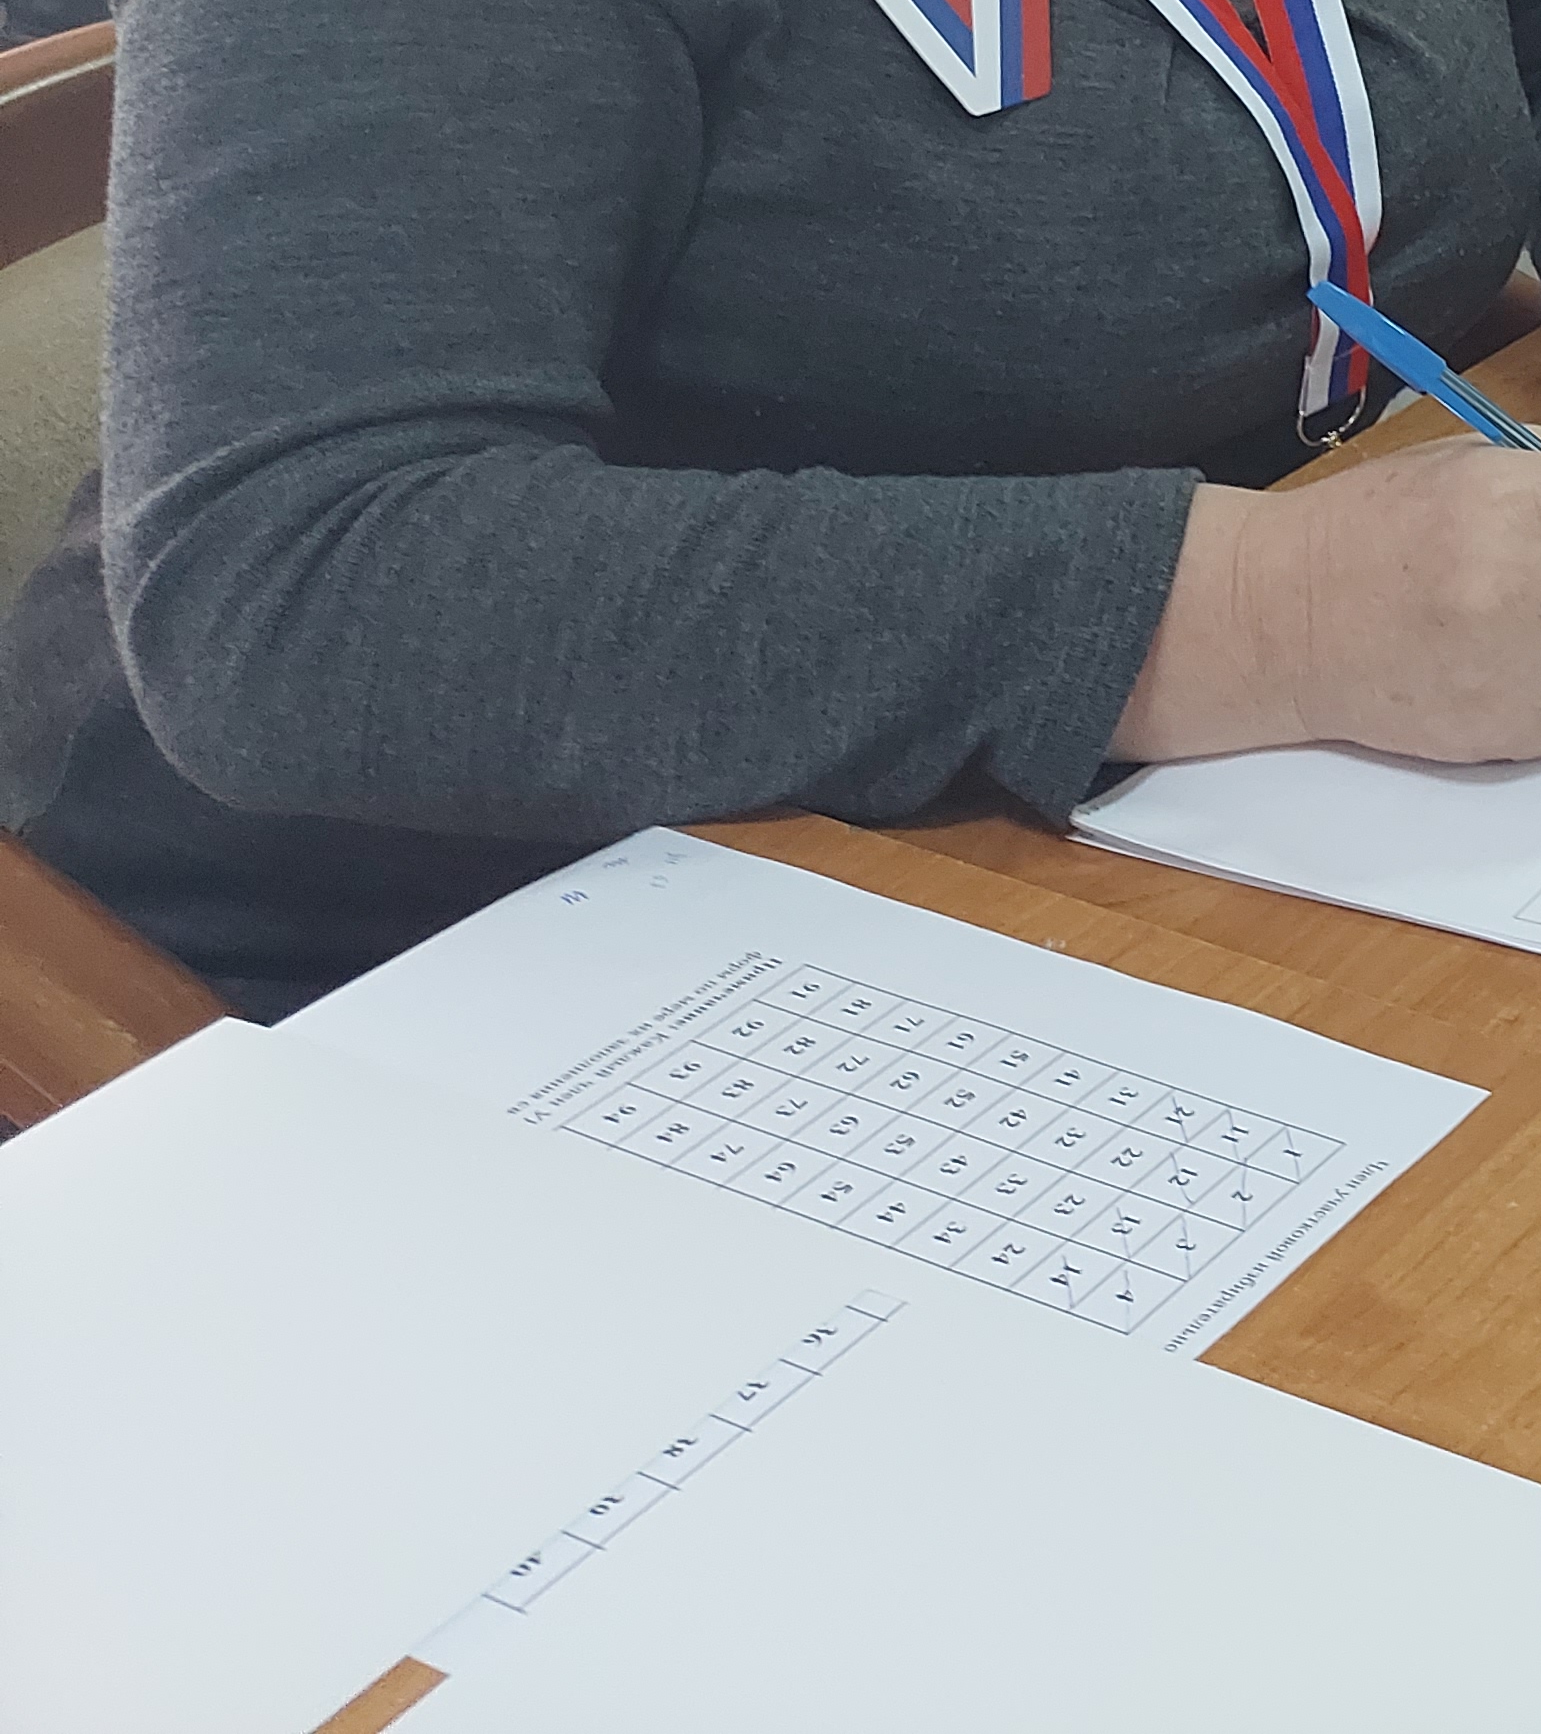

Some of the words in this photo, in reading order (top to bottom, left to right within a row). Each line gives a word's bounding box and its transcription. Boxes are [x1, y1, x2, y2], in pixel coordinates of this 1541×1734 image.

[785, 980, 825, 1001] 91
[836, 997, 875, 1017] 81
[727, 1017, 769, 1039] 92
[888, 1014, 927, 1035] 71
[778, 1034, 820, 1057] 82
[940, 1031, 980, 1052] 61
[663, 1059, 706, 1082] 93
[831, 1052, 873, 1075] 72
[994, 1049, 1034, 1071] 51
[714, 1077, 758, 1100] 83
[884, 1070, 926, 1093] 62
[1049, 1067, 1088, 1089] 41
[768, 1095, 811, 1119] 73
[939, 1088, 981, 1112] 52
[1104, 1085, 1144, 1107] 31
[596, 1102, 641, 1126] 94
[821, 1114, 865, 1138] 63
[994, 1107, 1036, 1130] 42
[1159, 1103, 1199, 1126] 21
[649, 1121, 693, 1145] 84
[1050, 1125, 1092, 1150] 32
[1216, 1122, 1256, 1145] 11
[703, 1140, 748, 1165] 74
[877, 1133, 920, 1158] 53
[1106, 1144, 1148, 1169] 22
[757, 1159, 802, 1184] 64
[933, 1152, 976, 1177] 43
[1164, 1164, 1205, 1188] 12
[1344, 1158, 1391, 1190] Член
[813, 1179, 858, 1204] 54
[989, 1172, 1033, 1197] 33
[870, 1199, 915, 1225] 44
[1046, 1191, 1090, 1217] 23
[927, 1219, 972, 1245] 34
[1105, 1211, 1148, 1237] 13
[1259, 1188, 1356, 1263] участковой
[985, 1239, 1030, 1266] 24
[1044, 1260, 1089, 1288] 14
[1157, 1260, 1275, 1354] избирательно
